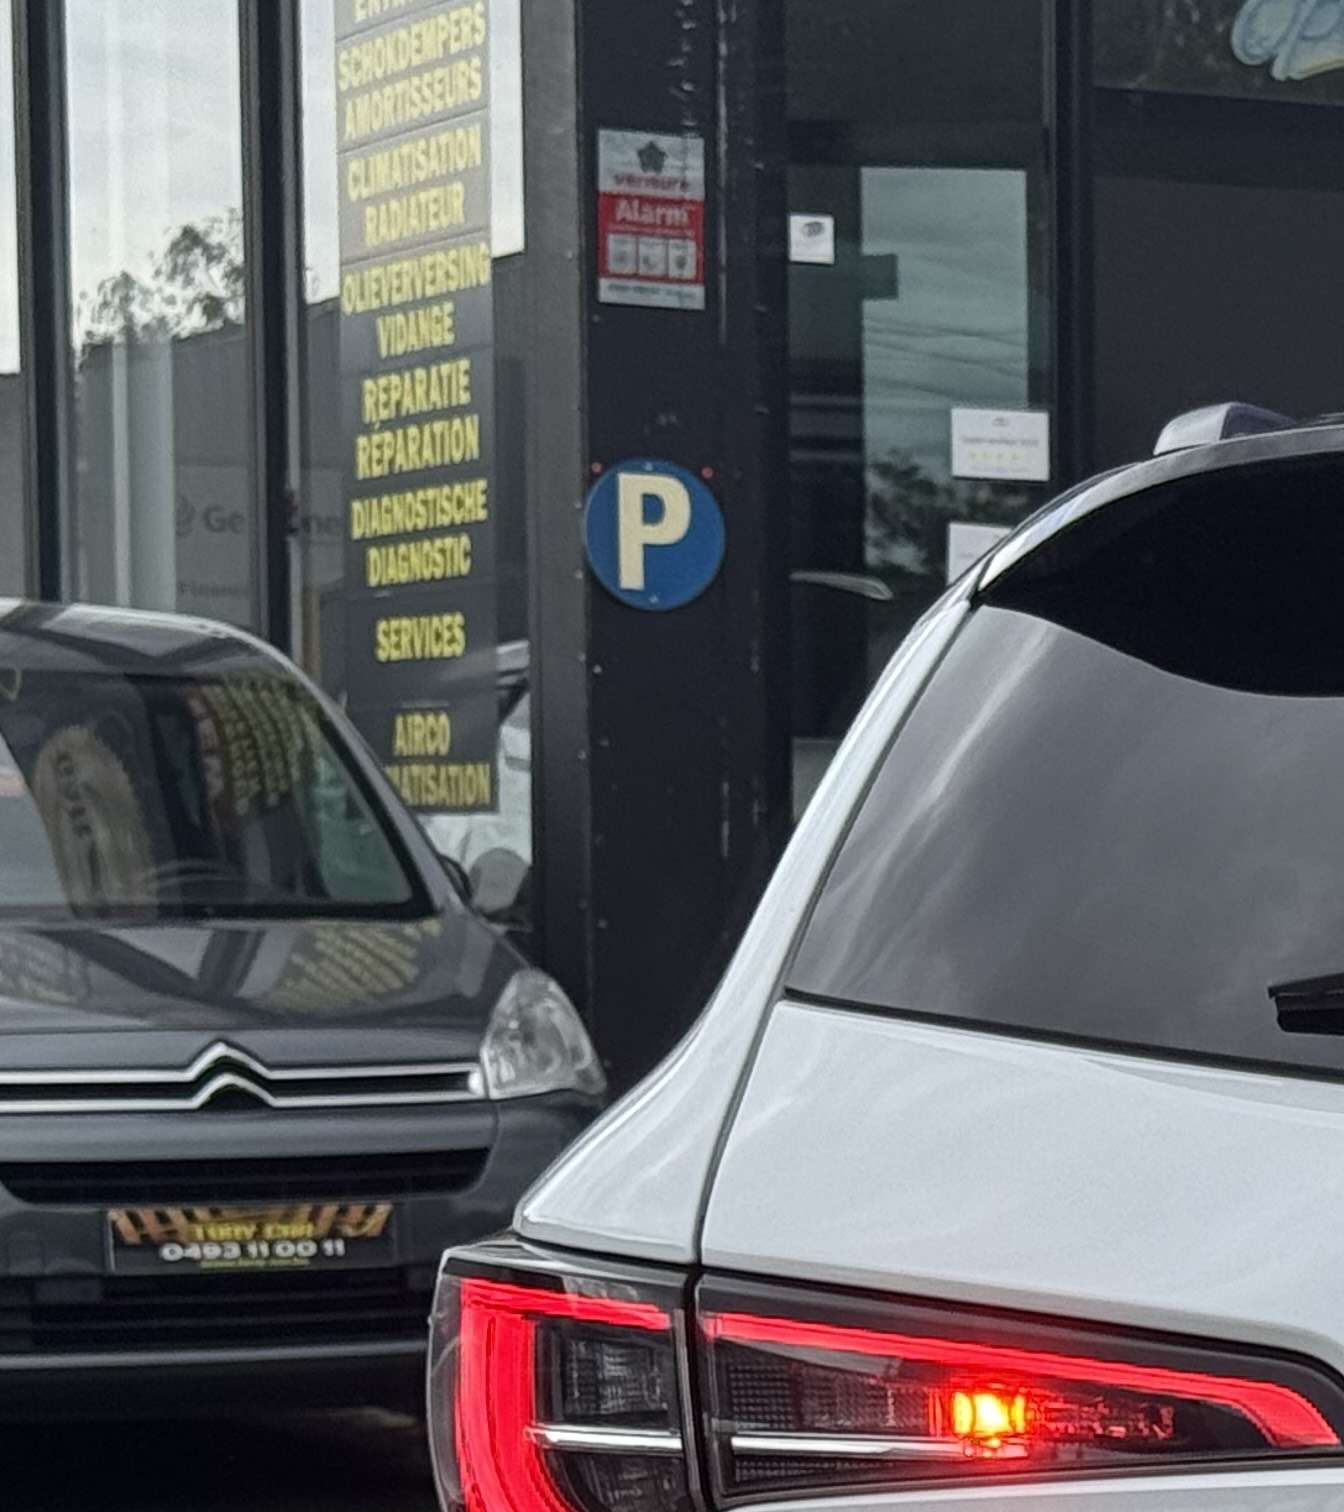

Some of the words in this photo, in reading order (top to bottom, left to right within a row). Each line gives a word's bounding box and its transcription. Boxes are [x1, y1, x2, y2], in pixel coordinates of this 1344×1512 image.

[339, 2, 486, 91] SCHOKDEMPERS
[345, 56, 482, 141] AMORTISSEURS
[347, 124, 481, 202] CLIMATISATION
[365, 181, 465, 247] RADIATEUR
[342, 243, 491, 316] OLIEVERVERSING
[377, 302, 455, 358] VIDANGE
[362, 358, 472, 425] REPARATIE
[356, 414, 480, 480] RÉPARATION
[351, 480, 488, 541] DIAGNOSTISCHE
[617, 472, 692, 591] P
[367, 534, 472, 588] DIAGNOSTIC
[375, 612, 466, 662] SERVICES
[394, 711, 451, 757] AIRCO
[384, 763, 491, 806] ATISATION
[160, 1241, 242, 1262] 0493
[248, 1240, 270, 1259] 11
[275, 1238, 318, 1258] 00
[322, 1237, 346, 1257] 11
